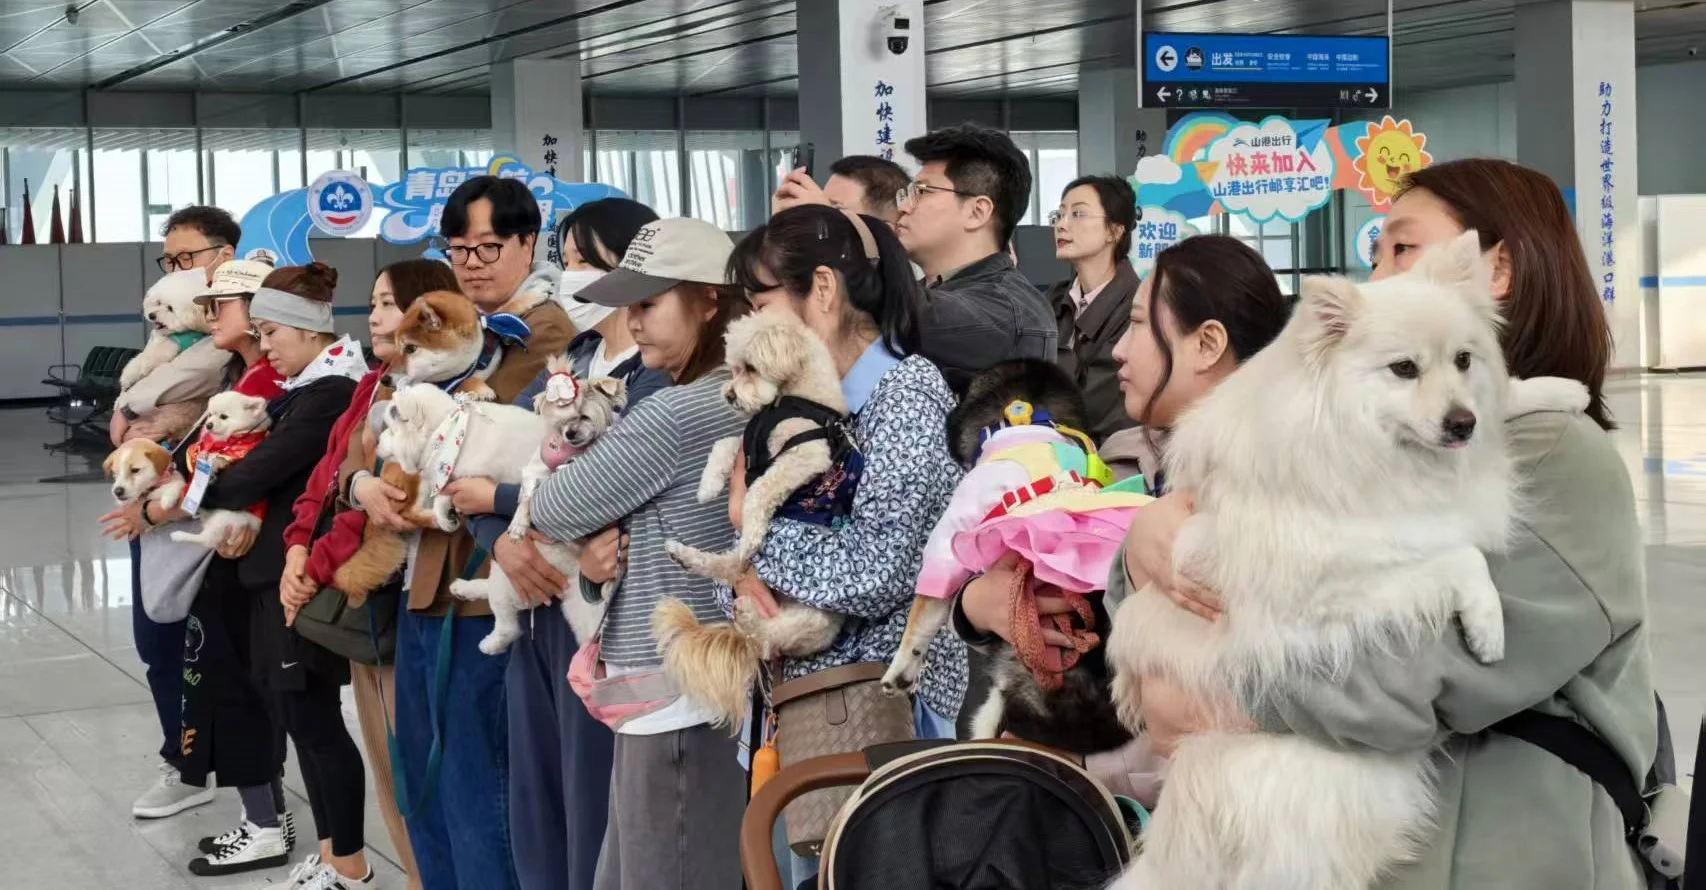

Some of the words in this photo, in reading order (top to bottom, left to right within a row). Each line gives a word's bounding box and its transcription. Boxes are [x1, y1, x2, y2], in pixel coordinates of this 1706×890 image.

[1211, 52, 1233, 66] 出发
[1251, 135, 1291, 147] 山港出行
[1226, 150, 1316, 176] 快来加入
[1138, 221, 1177, 240] 欢迎
